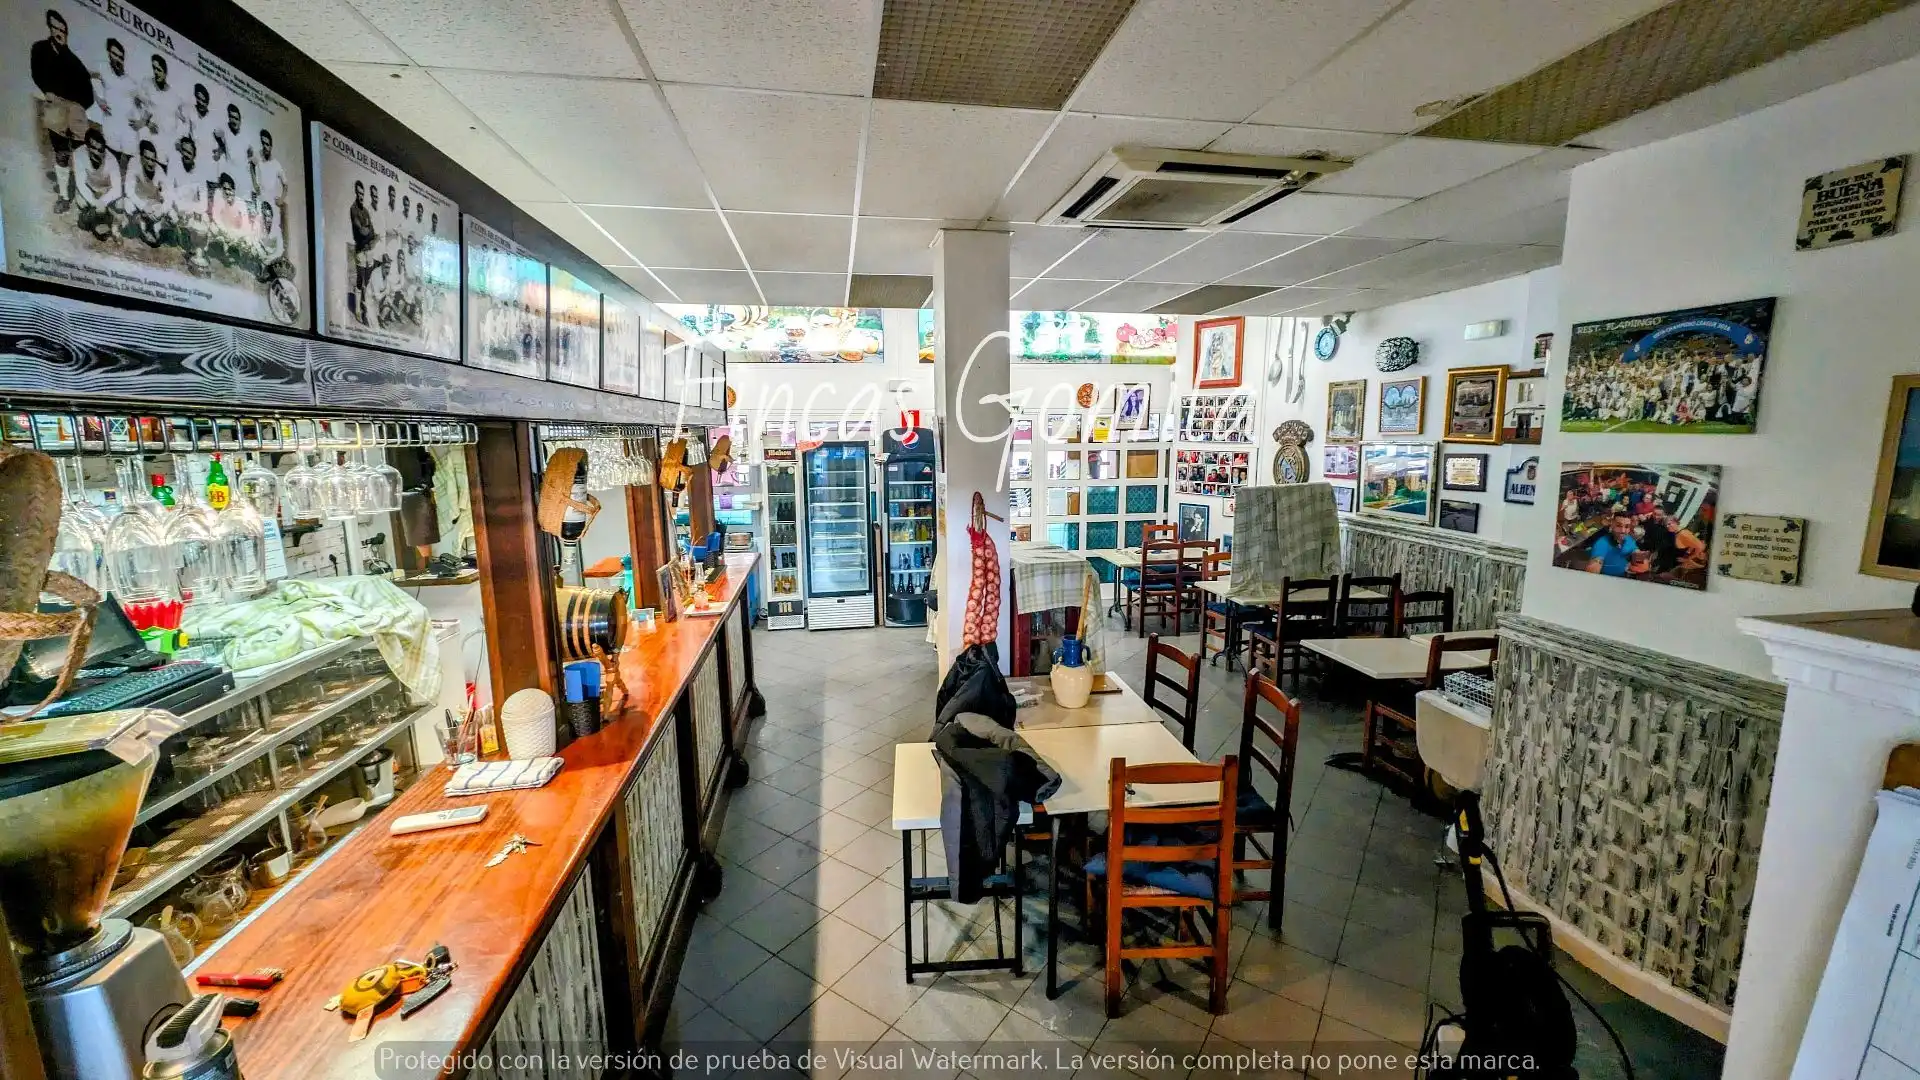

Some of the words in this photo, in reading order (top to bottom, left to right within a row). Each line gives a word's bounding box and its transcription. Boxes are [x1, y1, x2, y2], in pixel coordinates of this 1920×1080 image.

[106, 0, 175, 51] EUROPA
[332, 137, 356, 159] COPA
[356, 150, 369, 166] DE
[369, 157, 399, 183] EUROPA
[1817, 178, 1884, 202] BUENA
[1606, 316, 1663, 331] FLAMINGO
